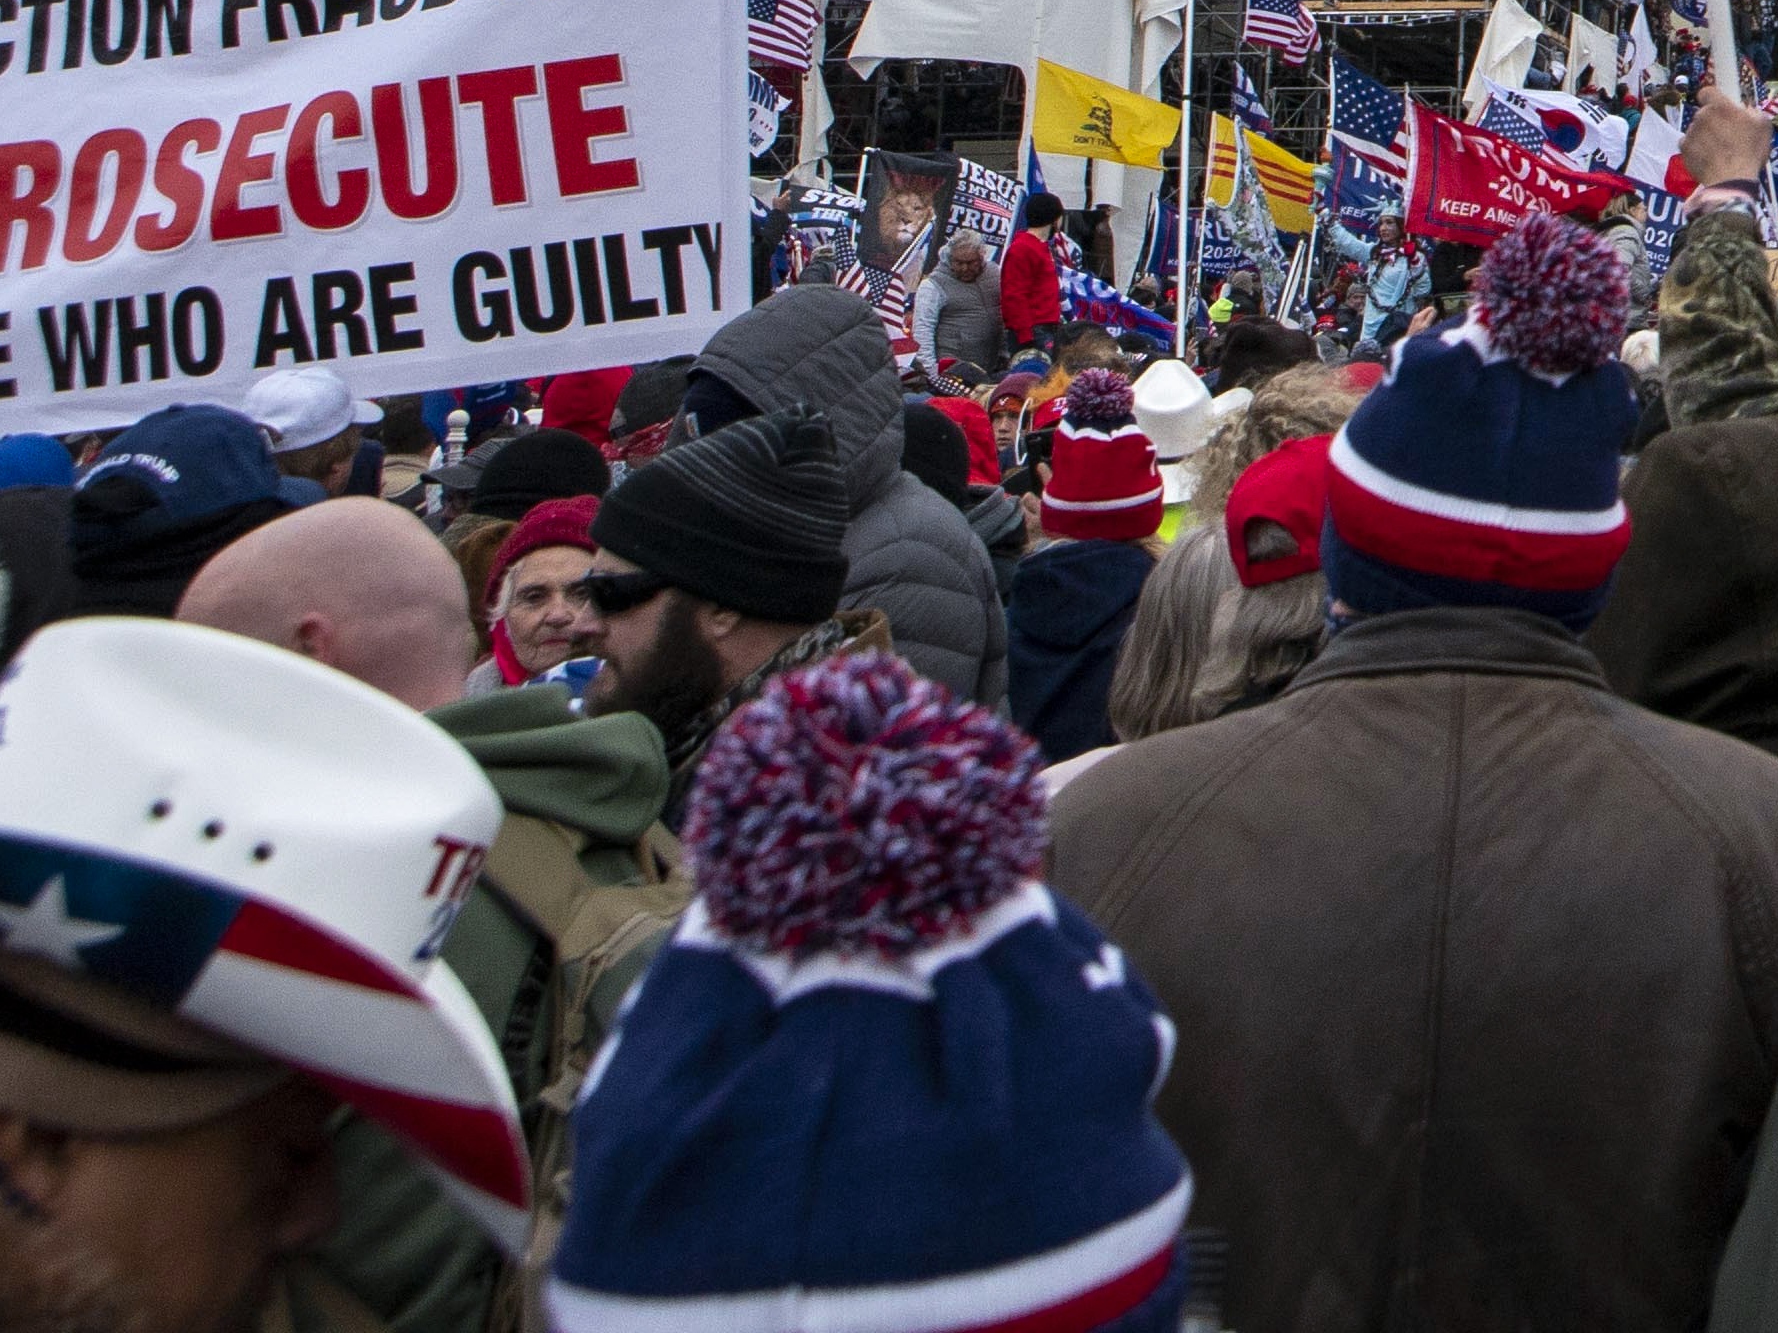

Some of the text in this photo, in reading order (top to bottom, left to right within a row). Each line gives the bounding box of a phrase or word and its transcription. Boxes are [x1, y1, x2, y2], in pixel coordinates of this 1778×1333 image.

[0, 53, 643, 271] ROSECUTE
[1339, 205, 1367, 218] KEEP
[1440, 197, 1481, 218] KEEP
[38, 285, 225, 392] WHO
[254, 260, 424, 369] ARE
[132, 453, 181, 483] TRUMP
